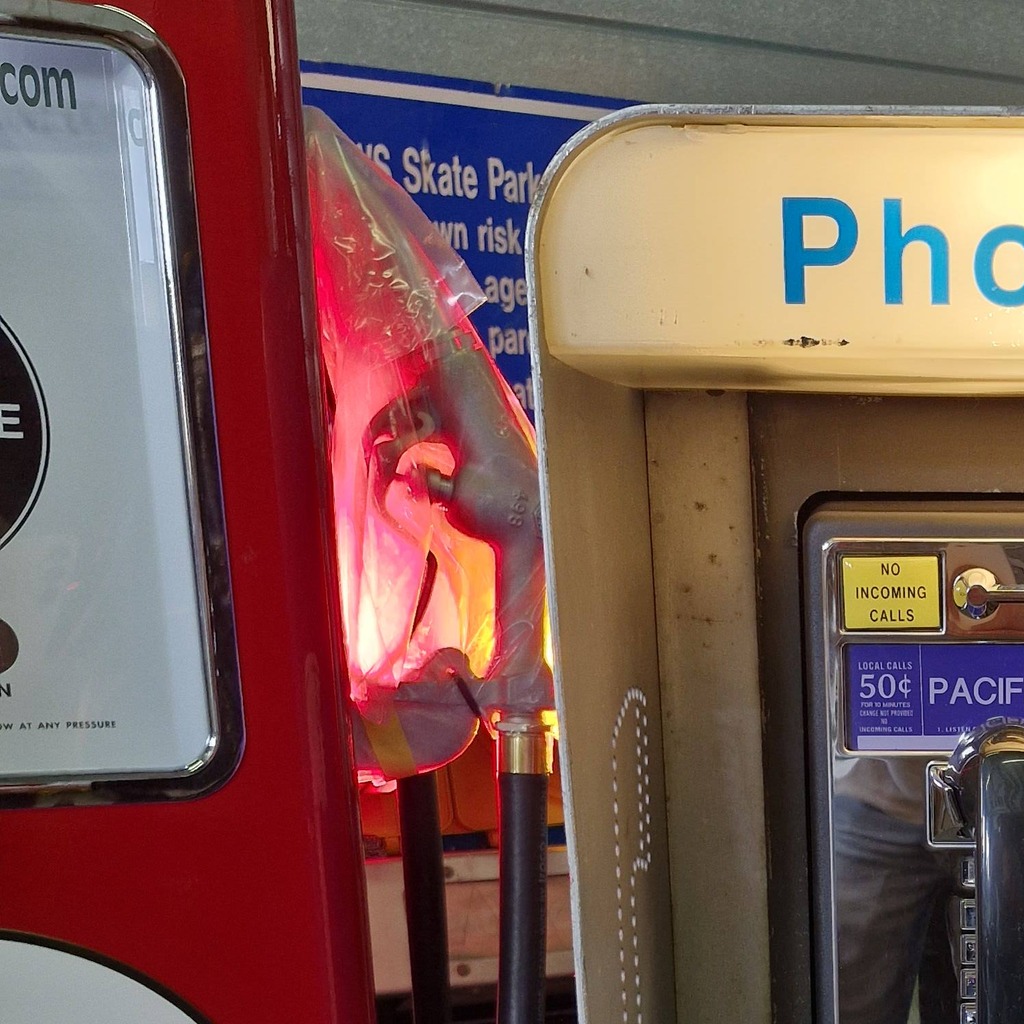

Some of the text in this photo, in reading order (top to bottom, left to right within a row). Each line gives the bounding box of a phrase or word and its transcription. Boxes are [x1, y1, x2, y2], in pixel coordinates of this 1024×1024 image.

[403, 146, 478, 199] Skate
[477, 217, 522, 255] risk
[881, 562, 900, 576] NO
[856, 586, 926, 599] INCOMING
[870, 609, 914, 622] CALLS
[858, 662, 912, 670] LOCAL CALLS
[860, 674, 912, 699] 50¢
[66, 720, 116, 729] PRESSURE
